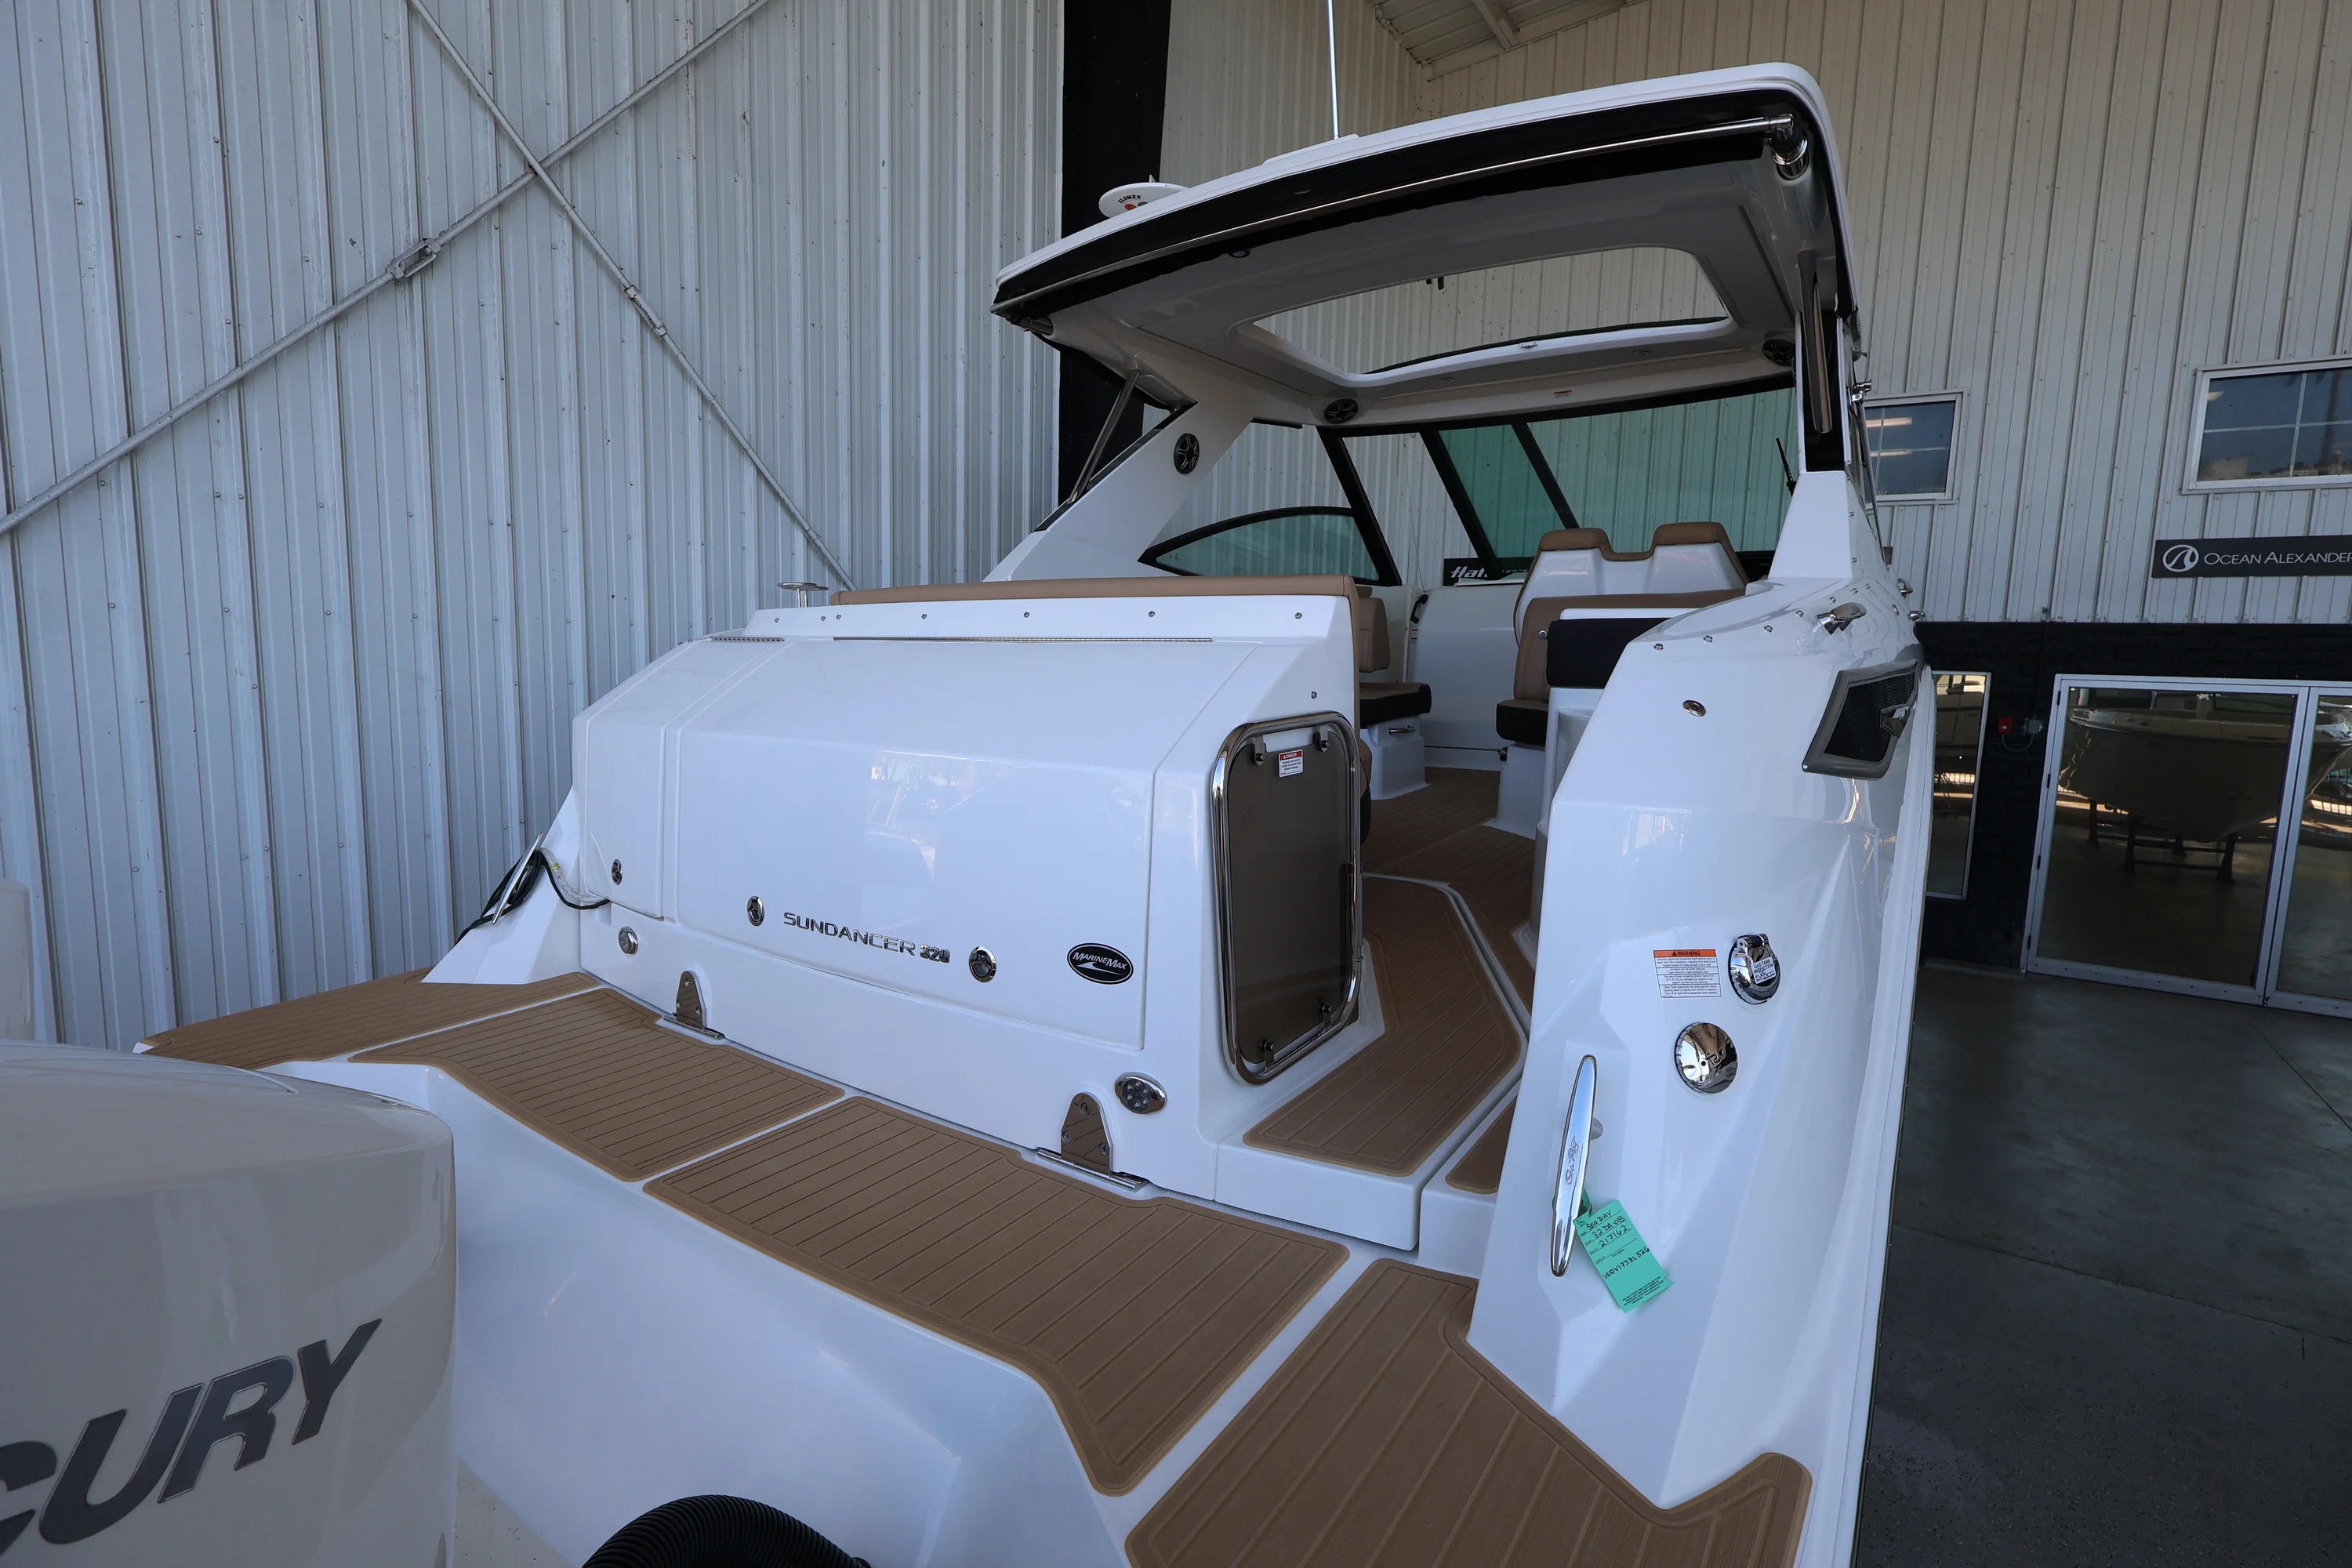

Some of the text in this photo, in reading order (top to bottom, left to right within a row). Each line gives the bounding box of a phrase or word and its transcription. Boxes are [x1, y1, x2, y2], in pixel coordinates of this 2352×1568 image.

[2204, 552, 2261, 564] OCEAN
[784, 912, 950, 964] SUNDANCER 320
[1586, 1210, 1612, 1231] SEA RAY
